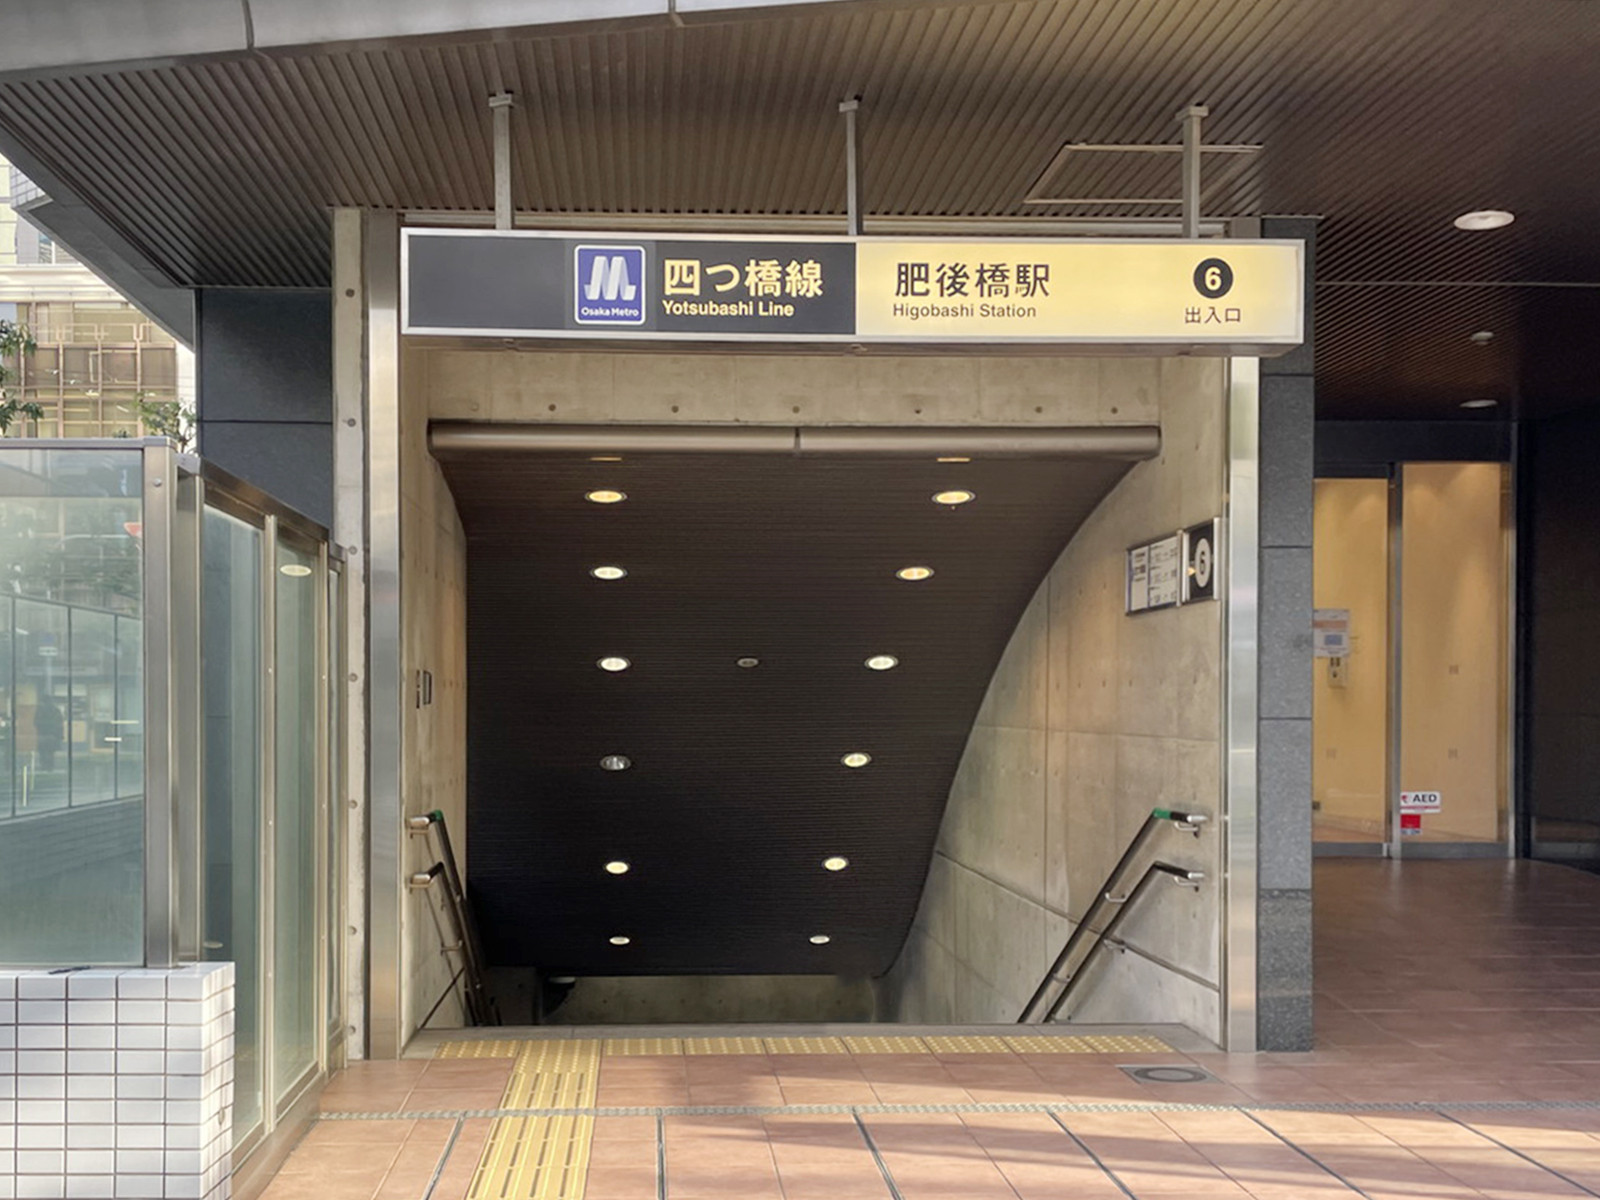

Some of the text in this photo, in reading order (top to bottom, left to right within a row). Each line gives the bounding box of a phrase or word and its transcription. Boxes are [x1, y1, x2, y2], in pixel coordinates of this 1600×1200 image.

[664, 259, 823, 298] 四つ橋線
[895, 262, 1050, 298] 肥後橋駅
[1204, 266, 1222, 291] 6
[581, 307, 639, 317] Osaka Metro
[663, 300, 795, 317] Yotsubashi Line
[893, 303, 1036, 320] Higobashi Station
[1185, 306, 1241, 324] 出入口
[1413, 794, 1437, 803] AED
